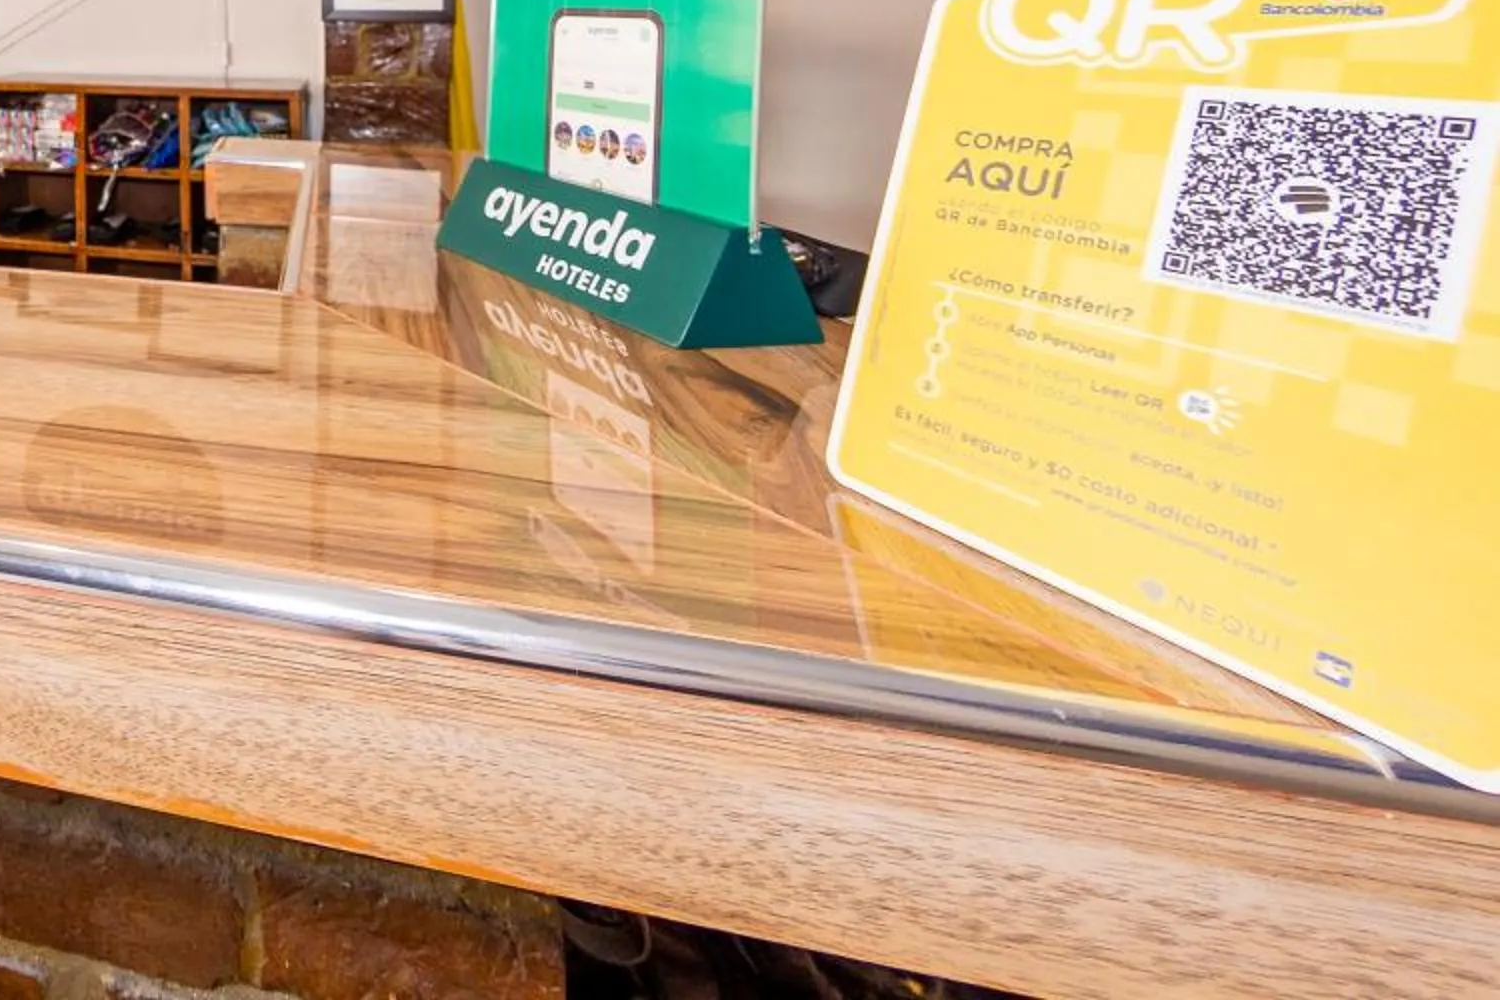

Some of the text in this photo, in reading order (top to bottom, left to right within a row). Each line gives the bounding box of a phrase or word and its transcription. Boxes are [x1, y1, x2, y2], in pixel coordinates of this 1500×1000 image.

[1260, 1, 1385, 17] Bancolombia
[954, 130, 1074, 161] COMPRA
[945, 156, 1071, 200] AQUÍ
[484, 186, 656, 271] ayenda
[935, 207, 1131, 256] QR de Bancolombia
[536, 255, 631, 303] HOTELES
[1021, 284, 1135, 322] transferir?
[1005, 322, 1039, 342] App
[1041, 331, 1117, 363] Personas
[1090, 378, 1129, 401] Leer
[1134, 392, 1165, 412] QR
[894, 404, 912, 422] Es
[960, 431, 1023, 464] seguro
[1027, 456, 1040, 471] y
[1076, 473, 1138, 506] costo
[1173, 594, 1283, 653] NEQUI
